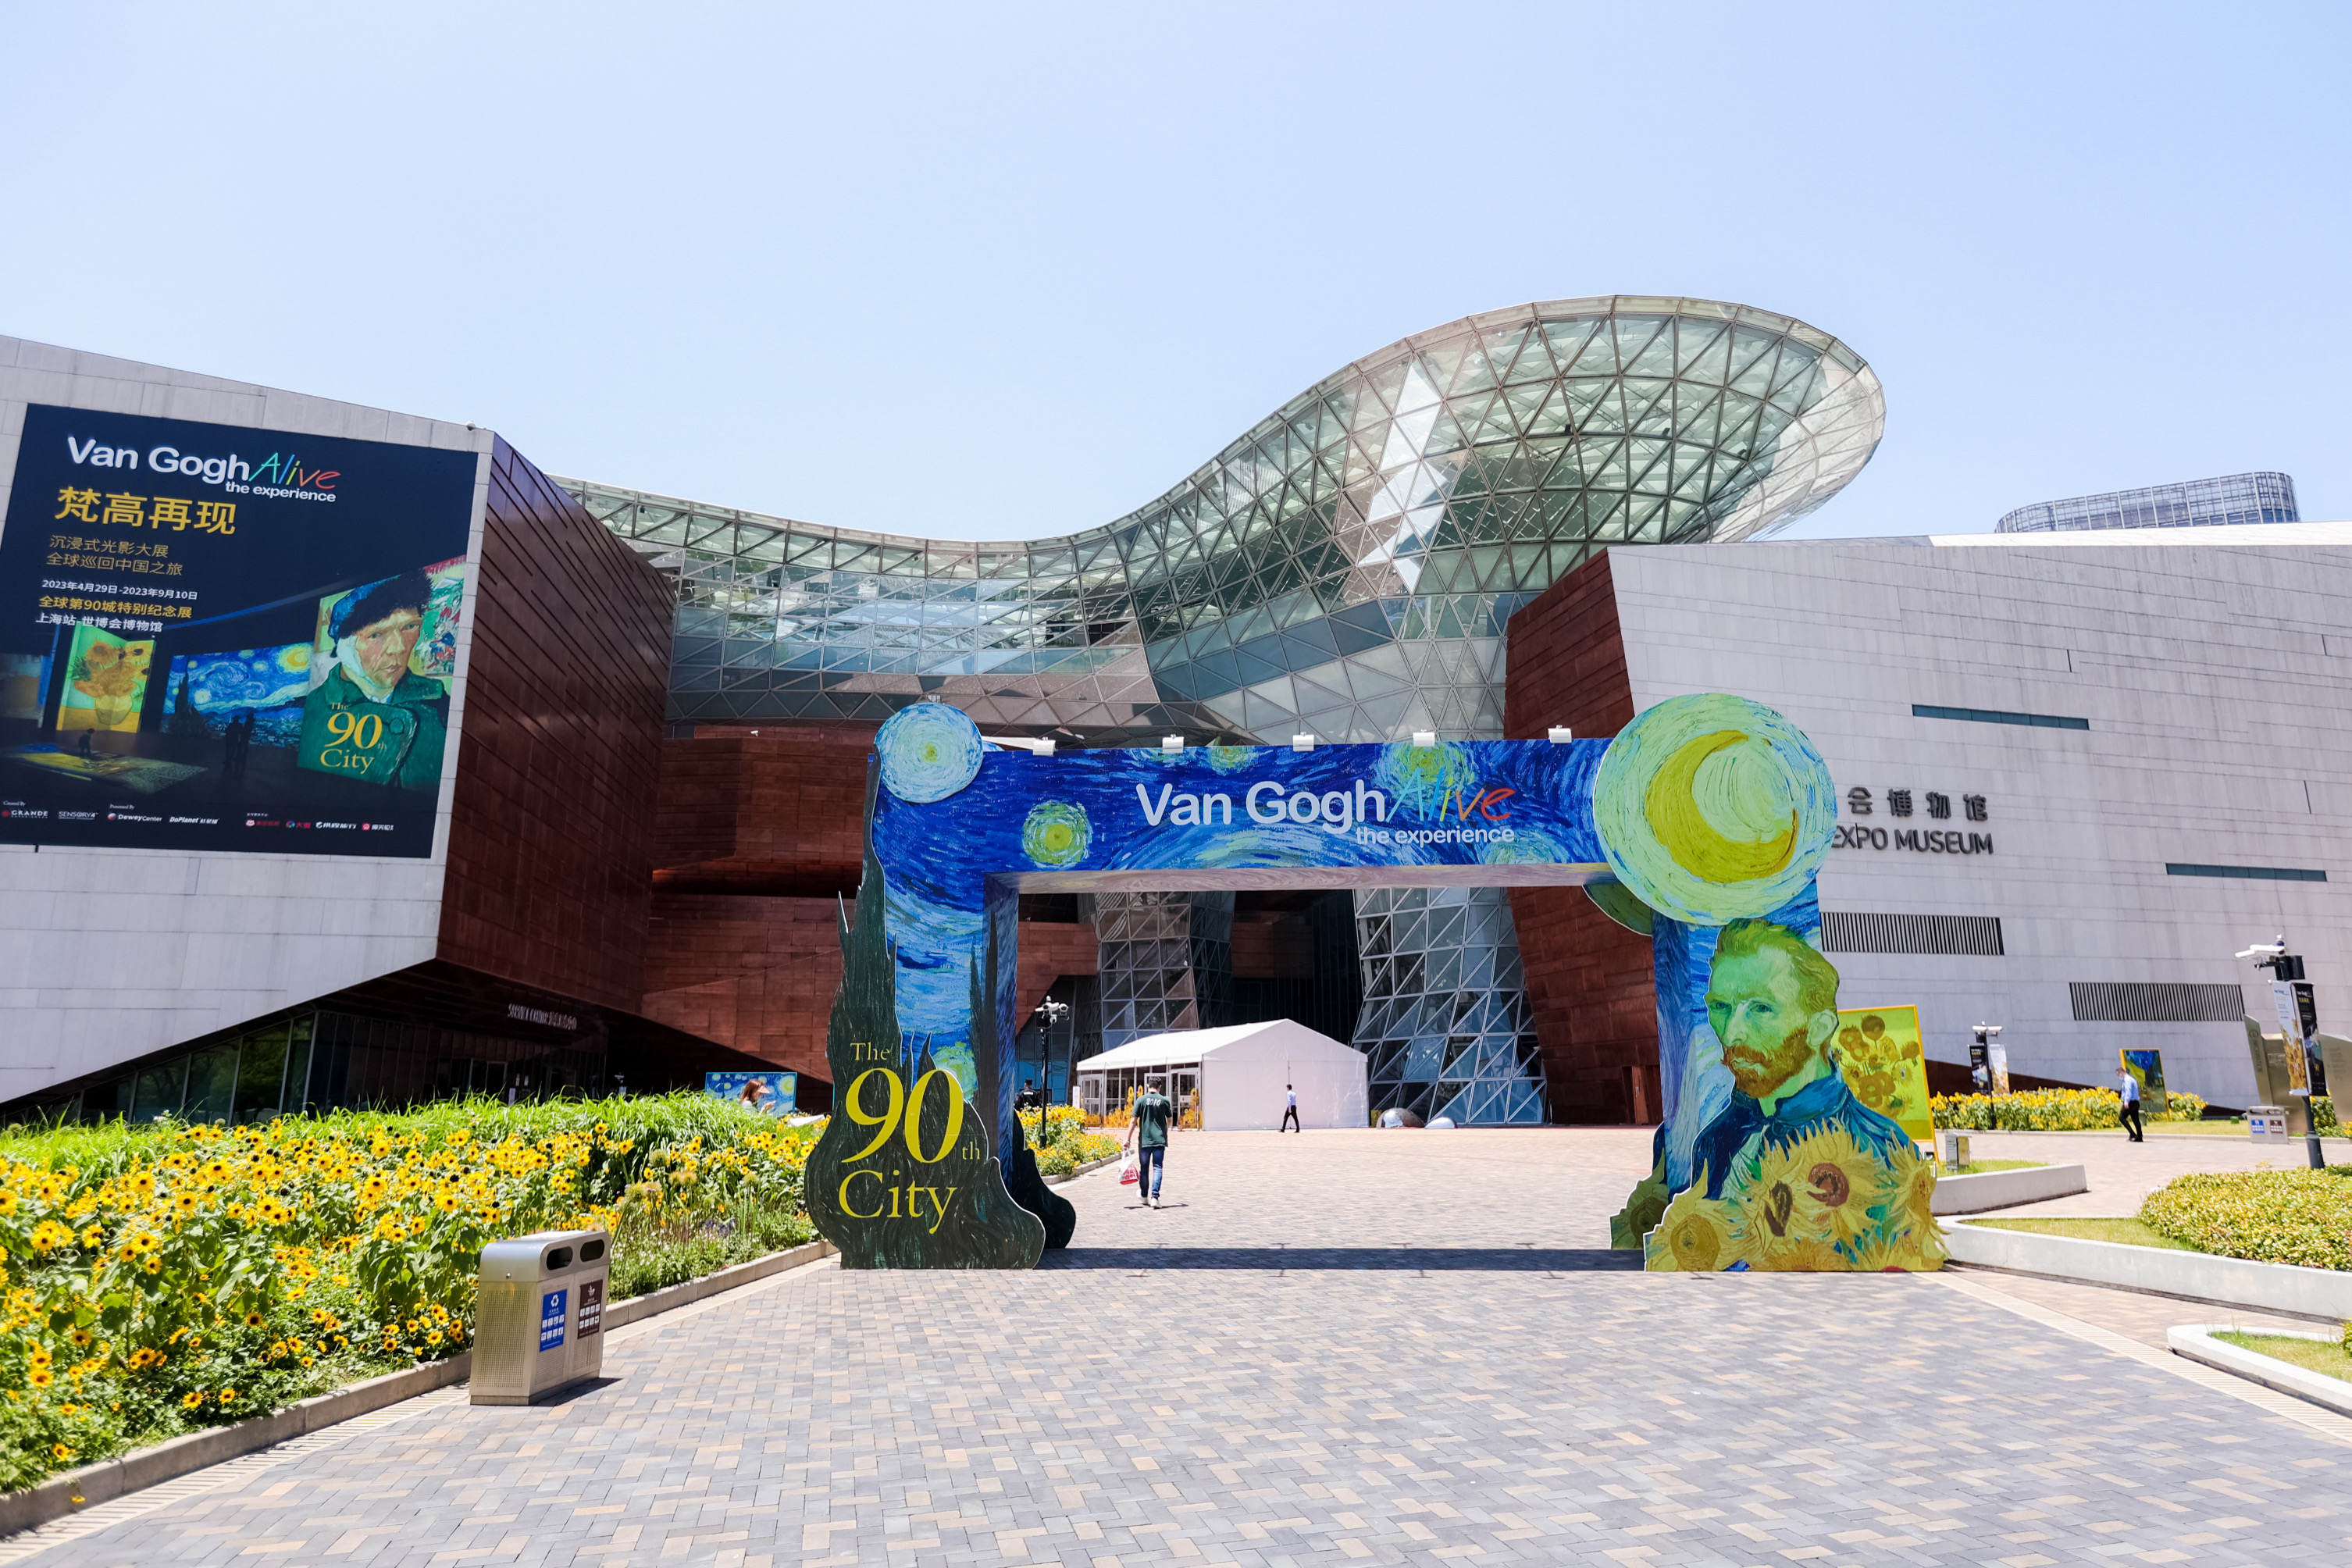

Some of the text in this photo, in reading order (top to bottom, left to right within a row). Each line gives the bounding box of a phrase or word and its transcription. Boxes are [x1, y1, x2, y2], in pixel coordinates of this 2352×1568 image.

[67, 435, 340, 489] Van Gogh Alive
[226, 481, 337, 503] the experience
[55, 486, 237, 535] 梵高再现
[50, 534, 169, 558] 沉浸式光影大展
[46, 552, 184, 576] 全球巡回中国之旅
[39, 595, 193, 618] 全球第90城特别纪念展
[320, 748, 375, 775] City
[1136, 766, 1516, 834] Van Gogh Alive
[1848, 786, 1988, 821] 会博物馆
[1356, 825, 1515, 849] the experience
[1894, 829, 1994, 854] MUSEUM
[850, 1042, 891, 1061] The
[1146, 1098, 1161, 1107] 2010
[839, 1169, 958, 1235] City
